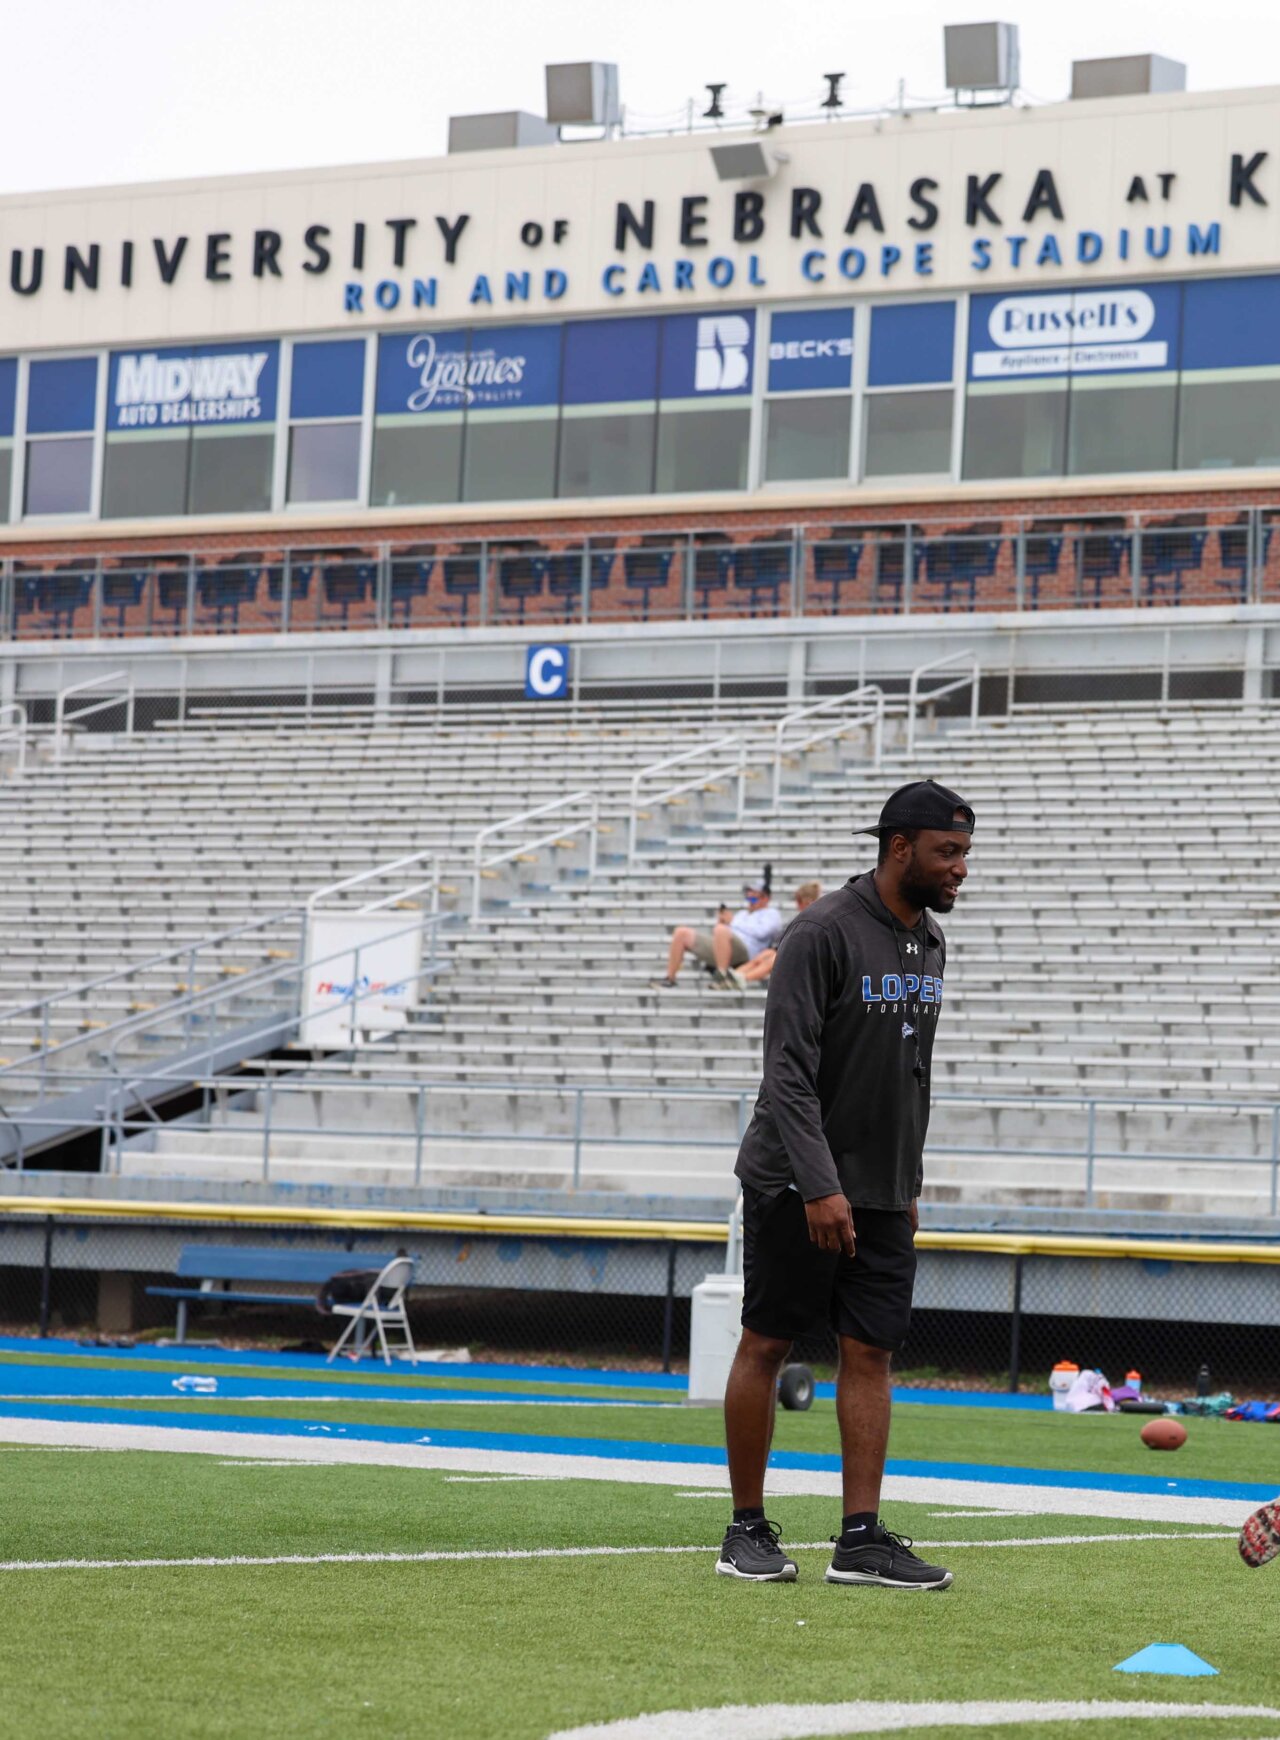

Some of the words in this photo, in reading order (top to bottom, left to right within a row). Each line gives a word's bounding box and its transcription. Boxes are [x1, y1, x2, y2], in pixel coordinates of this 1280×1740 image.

[11, 214, 470, 296] UNIVERSITY
[521, 220, 569, 248] OF
[614, 170, 1065, 252] NEBRASKA
[1126, 174, 1177, 203] AT
[345, 278, 438, 312] RON
[470, 268, 569, 303] AND
[602, 254, 765, 296] CAROL
[802, 242, 935, 282] COPE
[972, 222, 1222, 272] STADIUM
[1003, 302, 1140, 333] Russell's
[769, 337, 855, 361] BECK'S
[118, 404, 158, 426] AUTO
[161, 397, 262, 423] DEALERSHIPS
[529, 647, 564, 695] C
